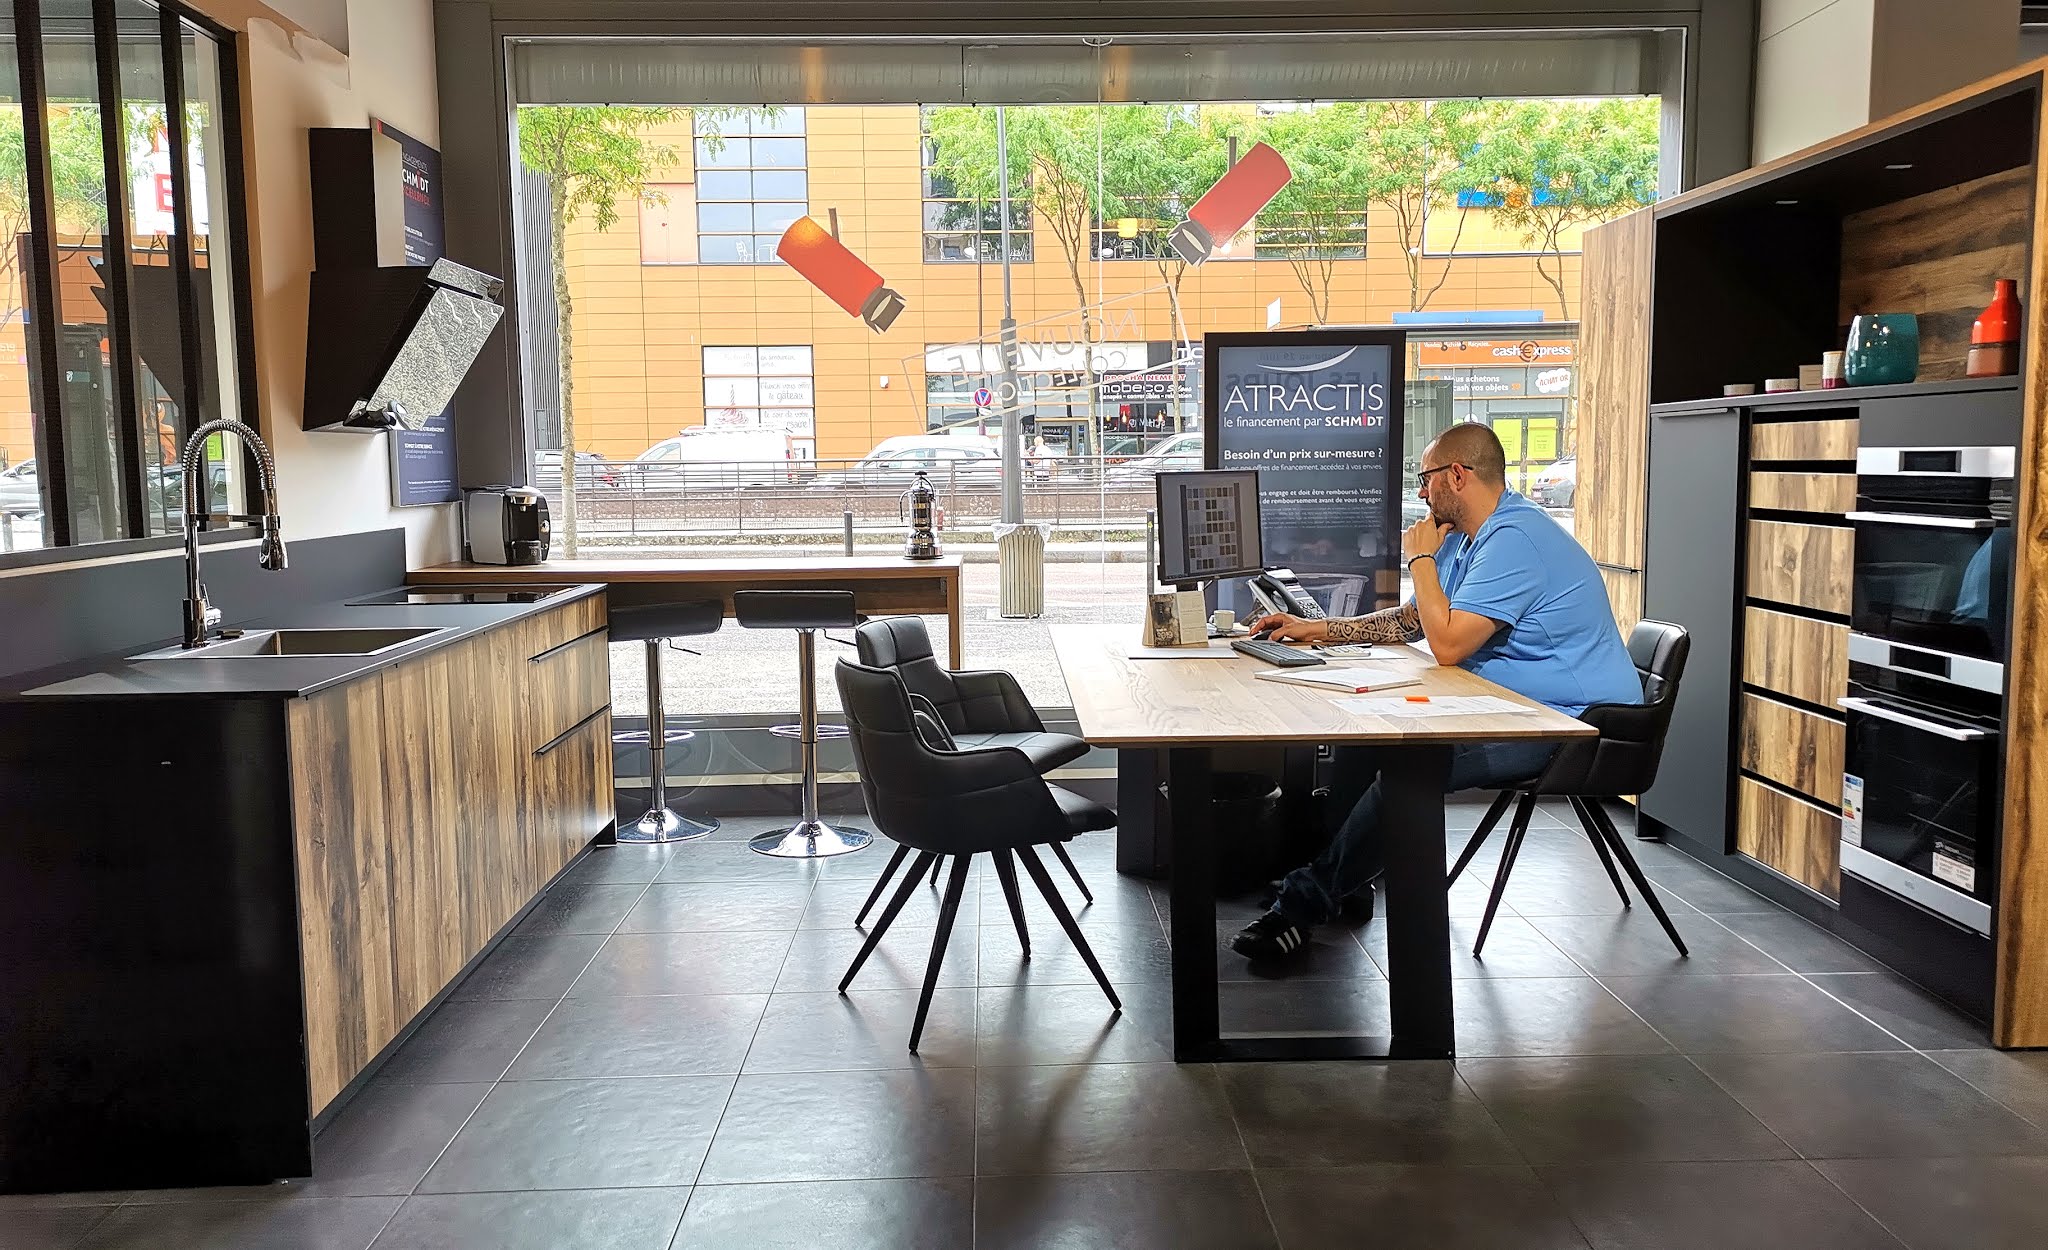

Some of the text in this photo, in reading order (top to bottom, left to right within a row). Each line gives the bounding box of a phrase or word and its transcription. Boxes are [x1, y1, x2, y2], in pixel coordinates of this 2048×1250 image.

[1099, 382, 1164, 393] mobeco
[1483, 384, 1509, 393] objets
[1224, 384, 1384, 413] ATRACTIS
[1224, 416, 1234, 428] le
[1236, 416, 1301, 428] financement
[1304, 418, 1323, 430] par
[1224, 449, 1261, 460] Besoin
[1290, 448, 1312, 462] prix
[1314, 450, 1376, 459] sur-mesure
[1378, 447, 1383, 458] ?
